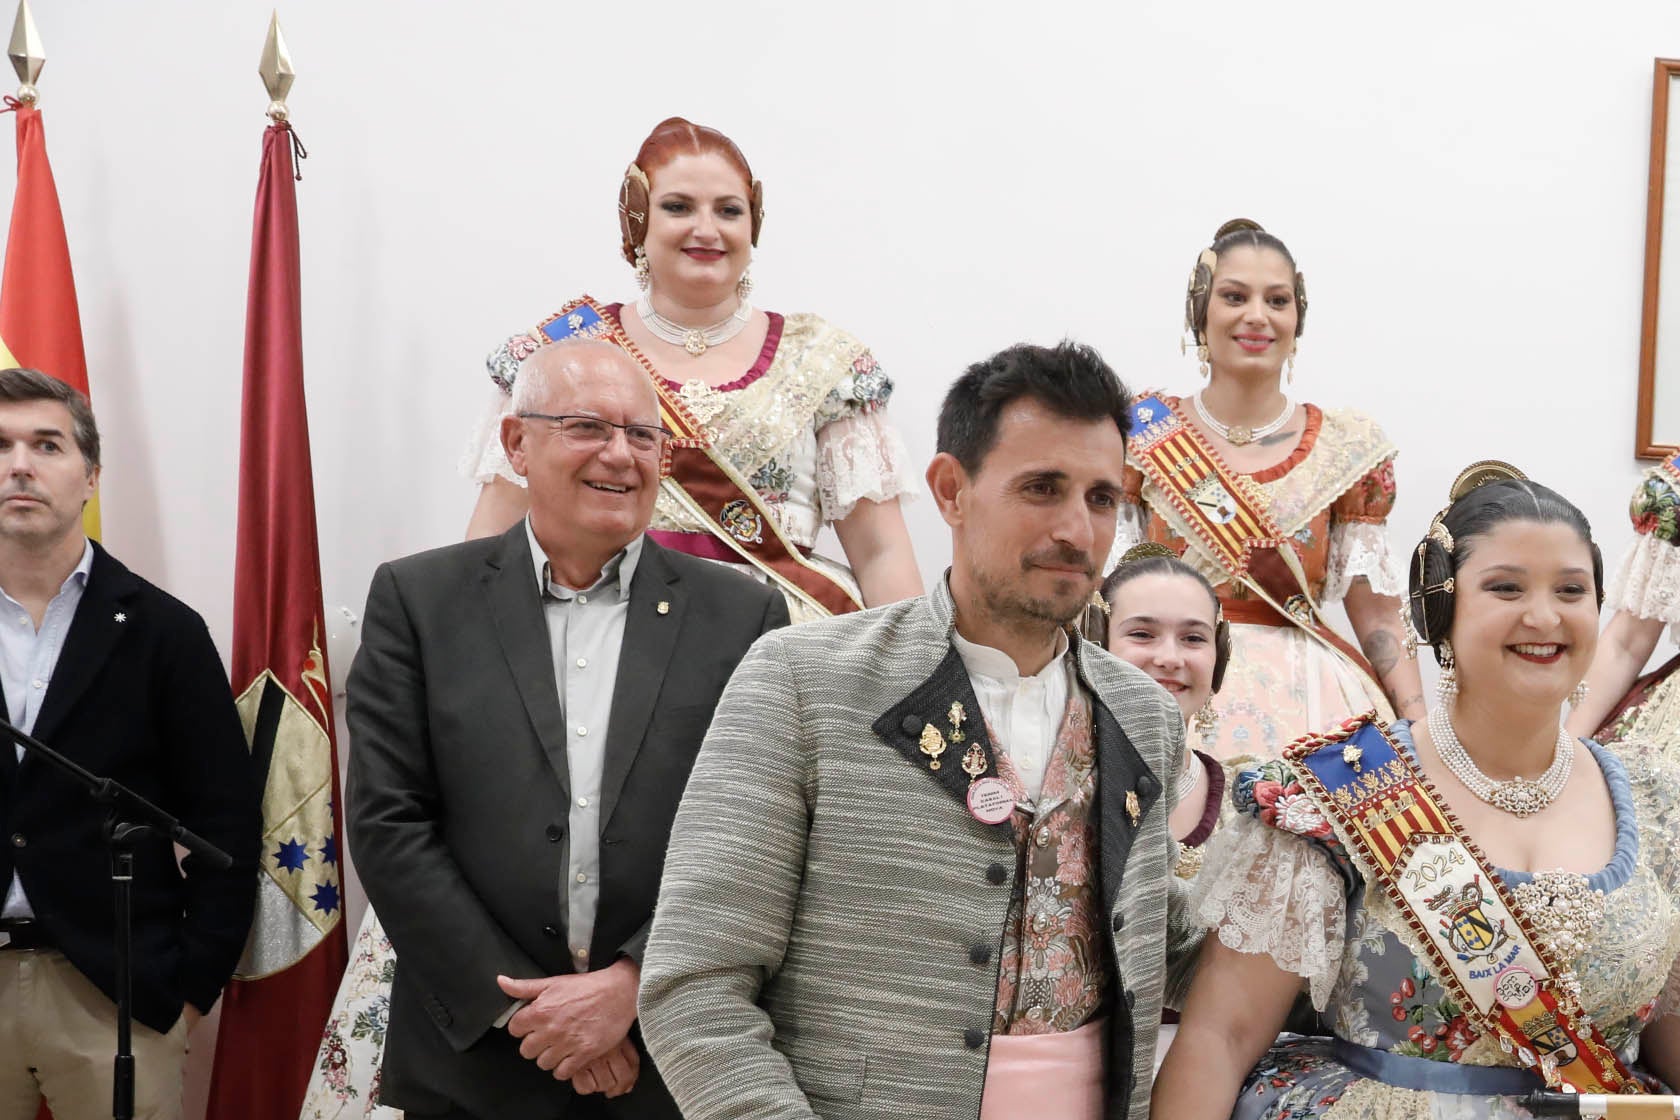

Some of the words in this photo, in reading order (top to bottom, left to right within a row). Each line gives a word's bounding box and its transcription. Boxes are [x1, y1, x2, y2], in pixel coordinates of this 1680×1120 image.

[1405, 847, 1465, 892] 2024
[1469, 968, 1492, 979] BAIX
[1493, 962, 1506, 974] LA
[1504, 945, 1521, 965] MAR
